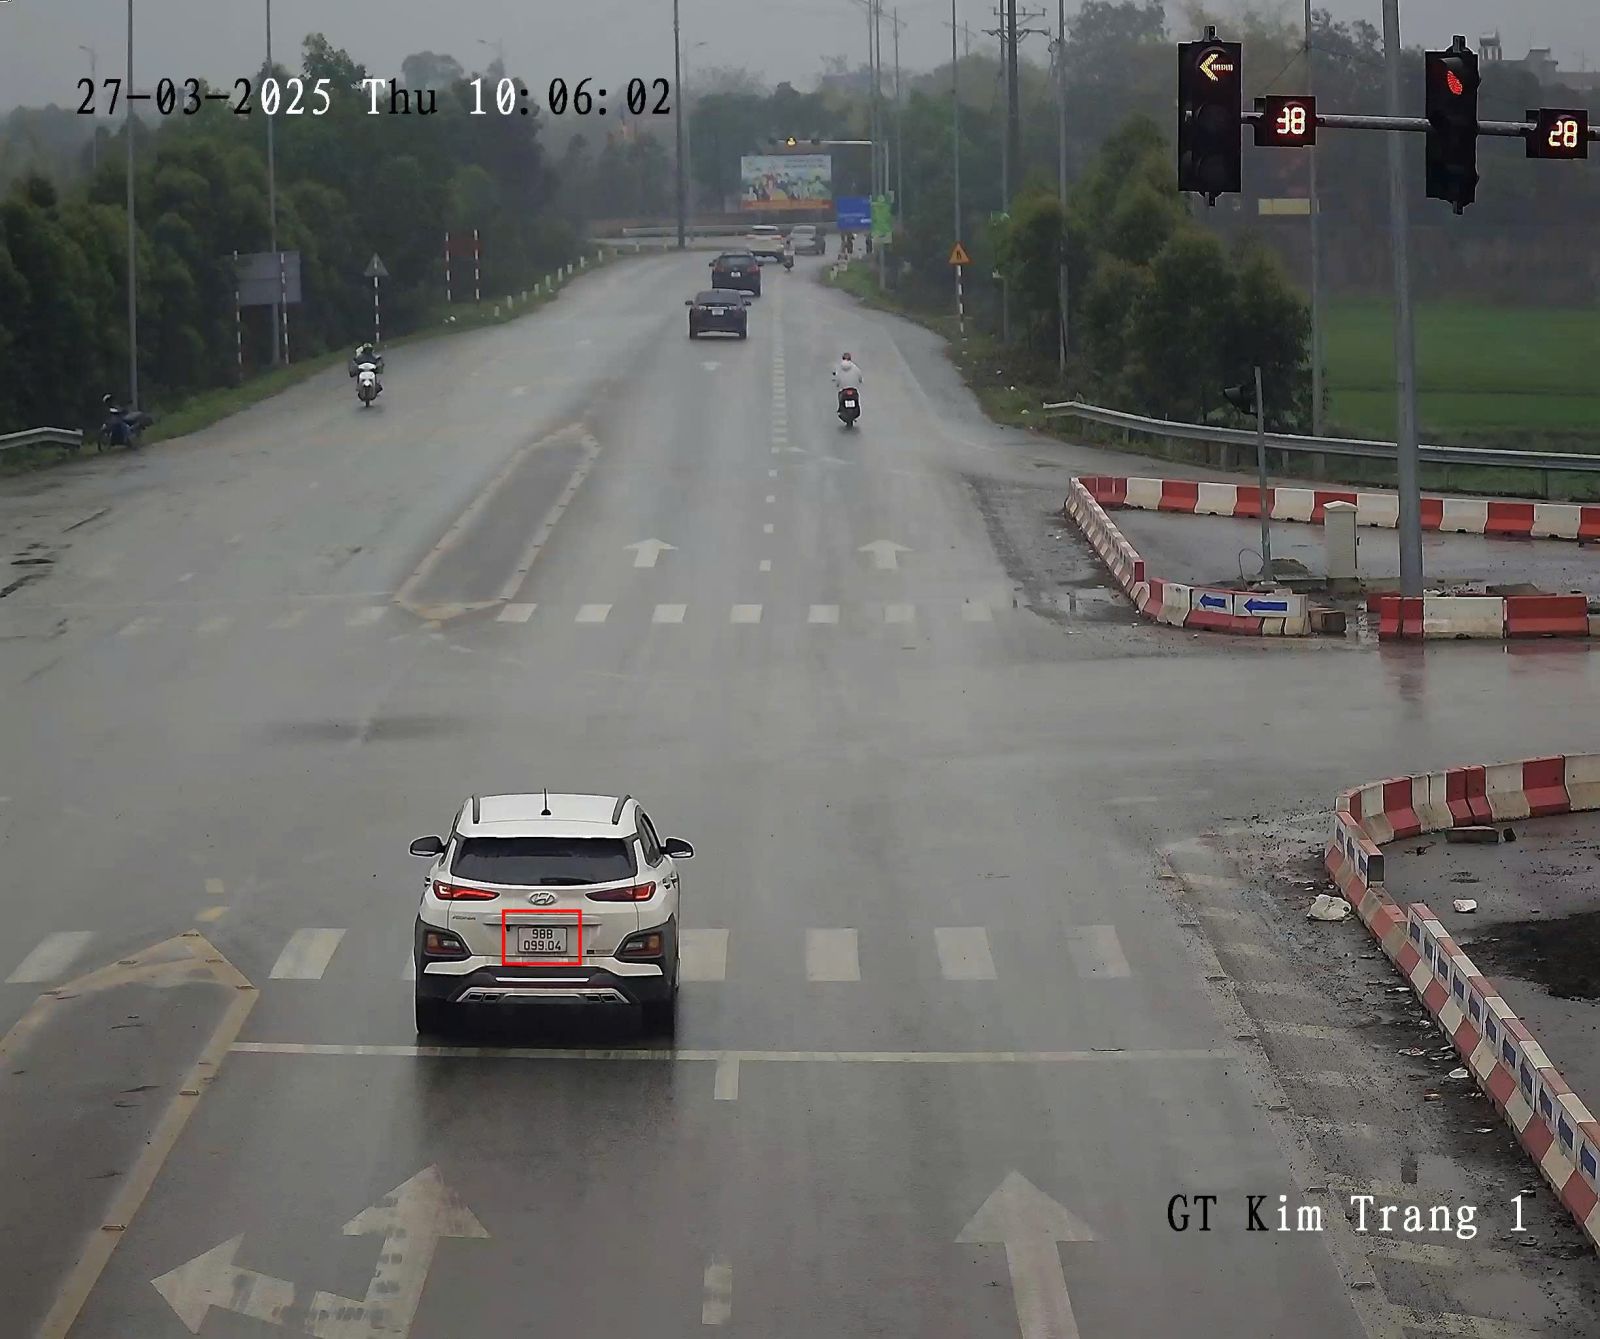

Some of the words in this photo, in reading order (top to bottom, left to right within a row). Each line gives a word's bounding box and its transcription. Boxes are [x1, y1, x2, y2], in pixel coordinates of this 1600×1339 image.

[1276, 106, 1306, 135] 38
[1548, 120, 1578, 148] 28
[532, 928, 553, 939] 98B
[523, 940, 562, 951] 099.04
